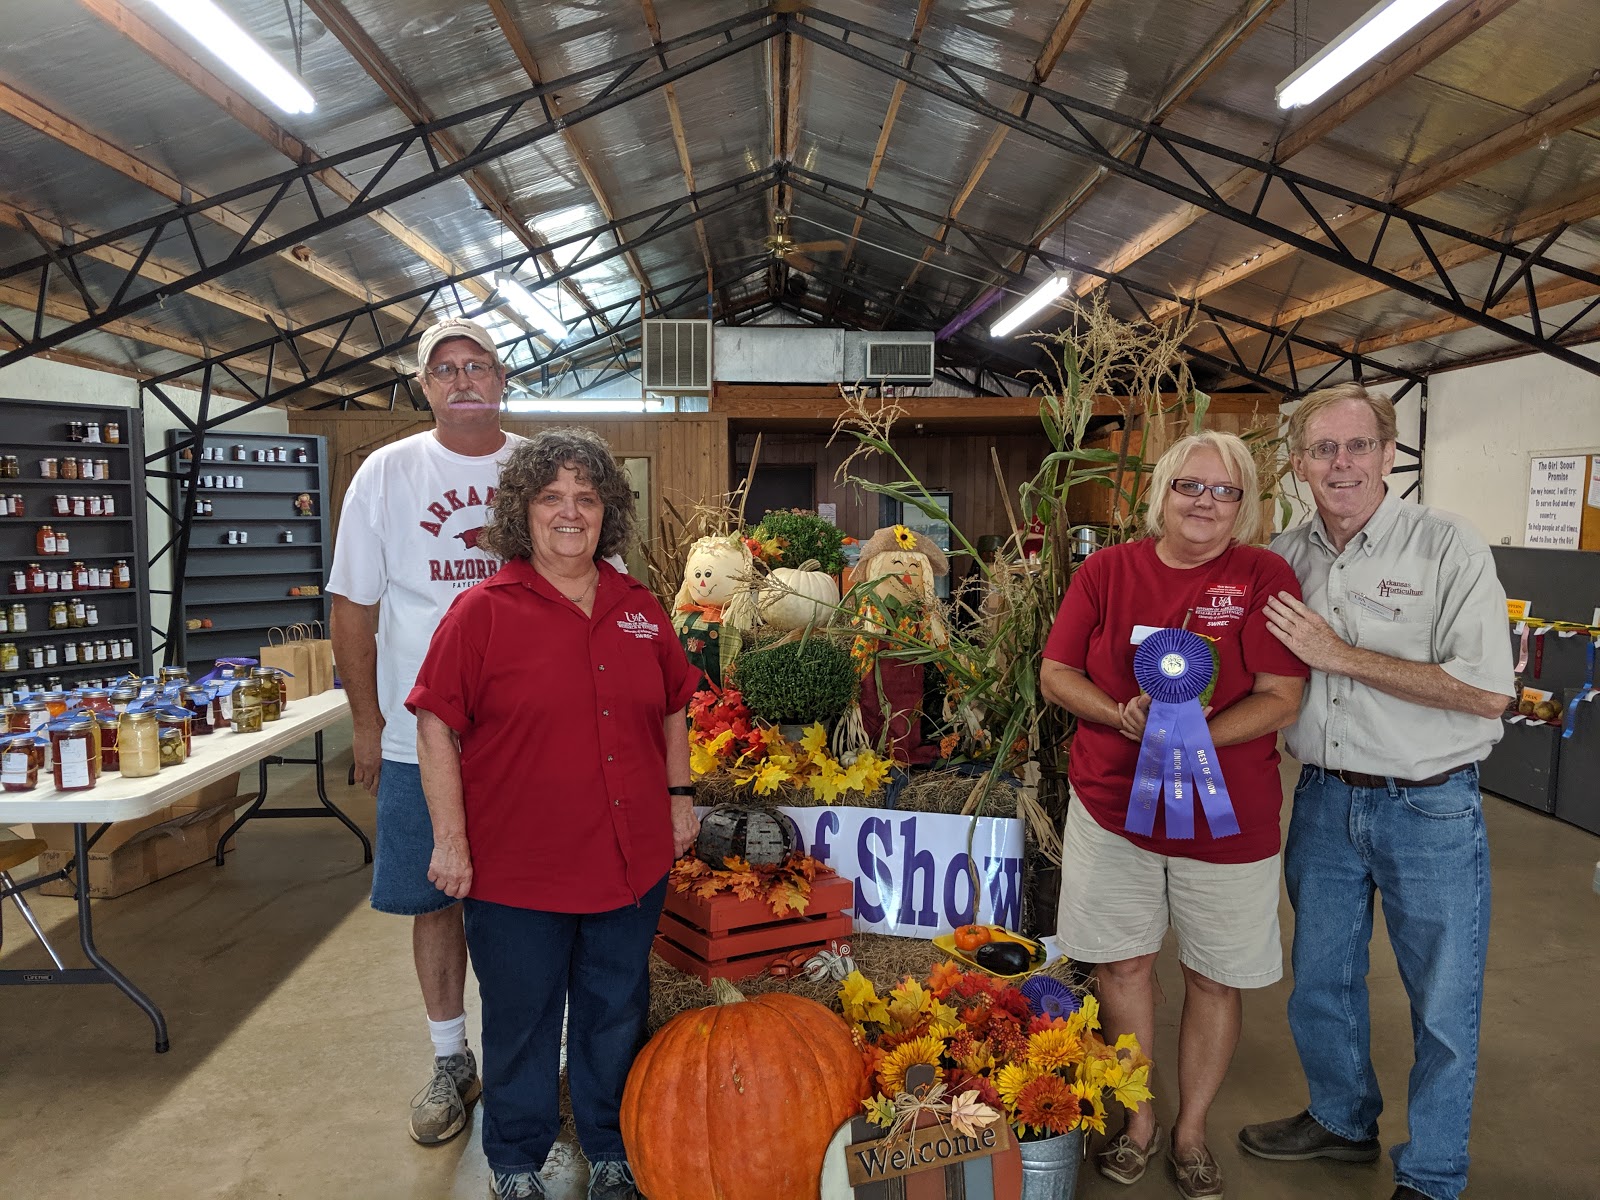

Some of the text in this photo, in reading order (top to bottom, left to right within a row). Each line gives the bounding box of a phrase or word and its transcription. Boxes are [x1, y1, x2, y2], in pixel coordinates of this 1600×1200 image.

[1539, 461, 1575, 470] The Girl Scout
[1548, 472, 1568, 481] Promise
[429, 559, 508, 581] RAZORB
[1377, 578, 1411, 590] Arkansas
[1379, 586, 1423, 597] Horticulture
[1173, 748, 1183, 799] JUNIOR DIVISION
[1196, 749, 1216, 795] BEST OF SHOW
[854, 815, 1024, 932] Show
[855, 1126, 997, 1178] Welcome
